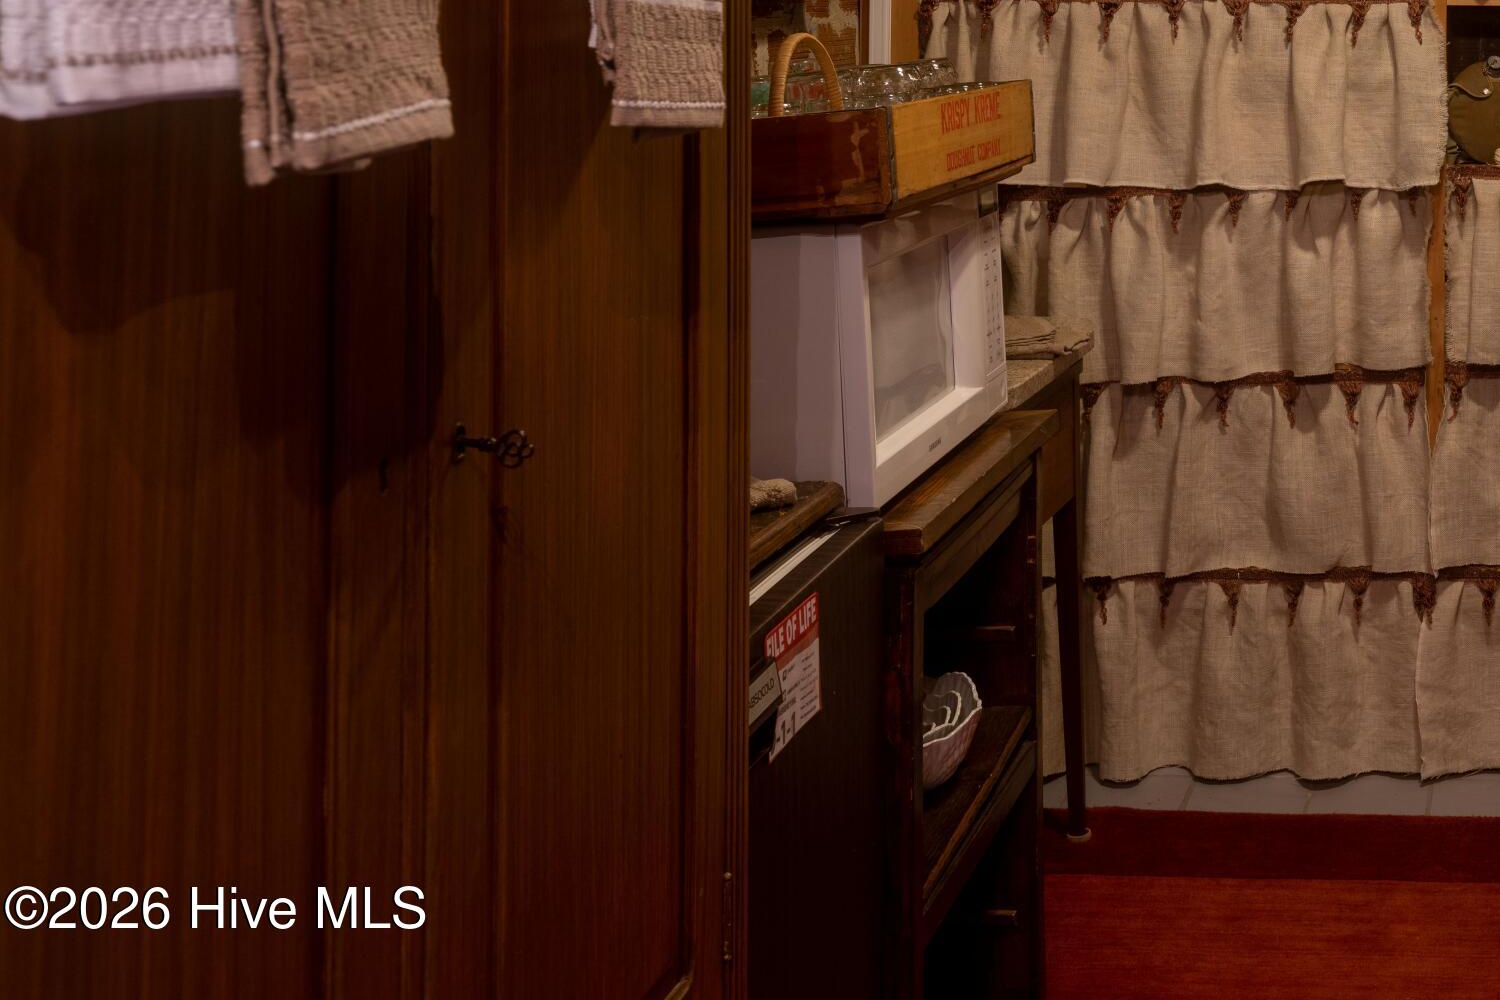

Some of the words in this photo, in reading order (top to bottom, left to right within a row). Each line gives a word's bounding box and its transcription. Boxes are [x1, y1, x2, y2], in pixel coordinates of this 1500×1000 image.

[940, 97, 970, 134] KRISPY
[974, 91, 1001, 124] KREME
[766, 625, 785, 657] FILE
[786, 613, 797, 646] OF
[798, 596, 817, 634] LIFE
